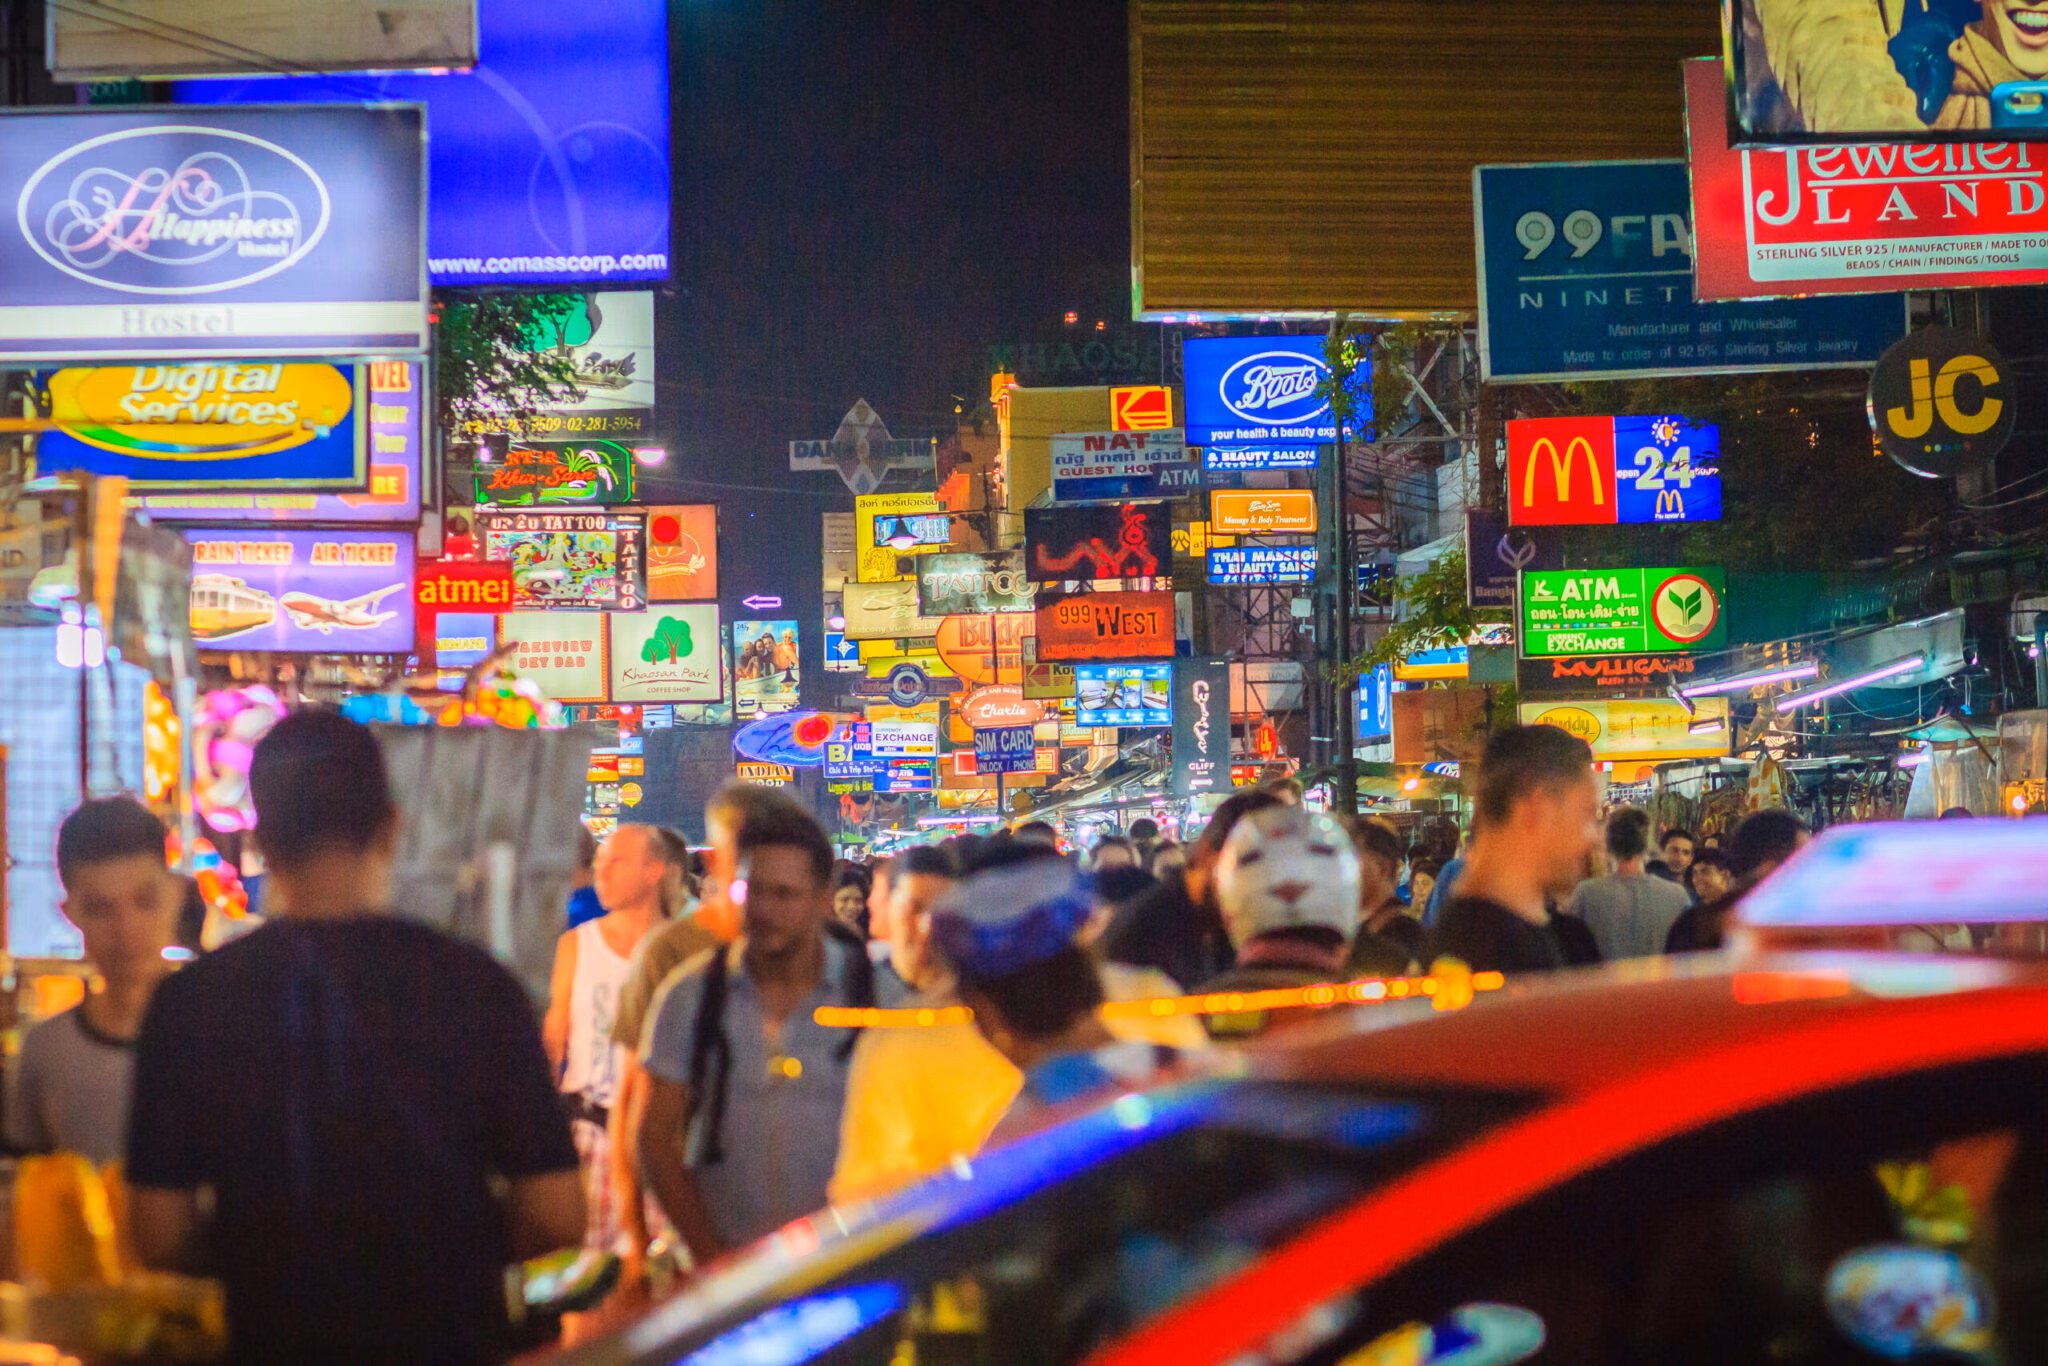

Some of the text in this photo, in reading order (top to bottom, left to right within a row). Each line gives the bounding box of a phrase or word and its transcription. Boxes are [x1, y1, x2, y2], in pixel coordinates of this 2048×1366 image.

[1811, 180, 2045, 225] LAND
[1757, 247, 1818, 261] STERLING
[1821, 244, 1863, 258] SILVER
[1866, 243, 1888, 256] 925
[1898, 240, 1983, 254] MANUFACTURER
[1991, 239, 2021, 249] MADE
[2021, 238, 2037, 248] TO
[428, 253, 667, 274] www.comasscorp.com
[1846, 260, 1880, 270] BEADS
[1888, 258, 1921, 268] CHAIN
[1930, 256, 1978, 266] FINDINGS
[1986, 253, 2020, 264] TOOLS
[1520, 286, 1680, 309] NINET
[121, 310, 235, 336] Hostel
[1608, 318, 1798, 337] Manufacturer and Wholesaler
[1563, 350, 1595, 364] Made
[1602, 350, 1614, 362] to
[1622, 348, 1652, 361] order
[1660, 346, 1672, 359] of
[1725, 341, 1770, 356] Sterling
[1776, 339, 1807, 354] Silver
[131, 363, 284, 402] Digital
[1234, 364, 1319, 410] Boots
[1887, 355, 2004, 439] JC
[119, 394, 299, 426] Services
[1083, 433, 1151, 452] NAT
[1211, 430, 1235, 442] your
[1236, 427, 1268, 439] health
[1270, 427, 1279, 438] &
[1280, 426, 1316, 439] beauty
[1208, 450, 1316, 462] & BEAUTY SALON
[1059, 465, 1115, 477] GUEST
[1160, 469, 1200, 486] ATM
[1616, 469, 1639, 480] open
[1634, 446, 1691, 490] 24
[542, 515, 607, 531] TATTOO
[193, 543, 396, 565] RAIN TICKET AIR TICKET
[1212, 551, 1246, 563] THAI
[620, 530, 639, 609] TATTOO
[1213, 564, 1224, 573] &
[1561, 577, 1621, 602] ATM
[1059, 604, 1158, 637] 999 WEST
[1547, 638, 1626, 652] EXCHANGE
[622, 666, 711, 682] Khaosan Park
[1108, 667, 1144, 679] Pillow
[981, 703, 1027, 718] Charlie
[854, 743, 871, 751] UOB
[875, 733, 934, 742] EXCHANGE
[976, 730, 1034, 753] SIM CARD
[740, 766, 791, 777] INDIAN
[977, 762, 1003, 774] UNLOCK
[1013, 759, 1035, 771] PHONE
